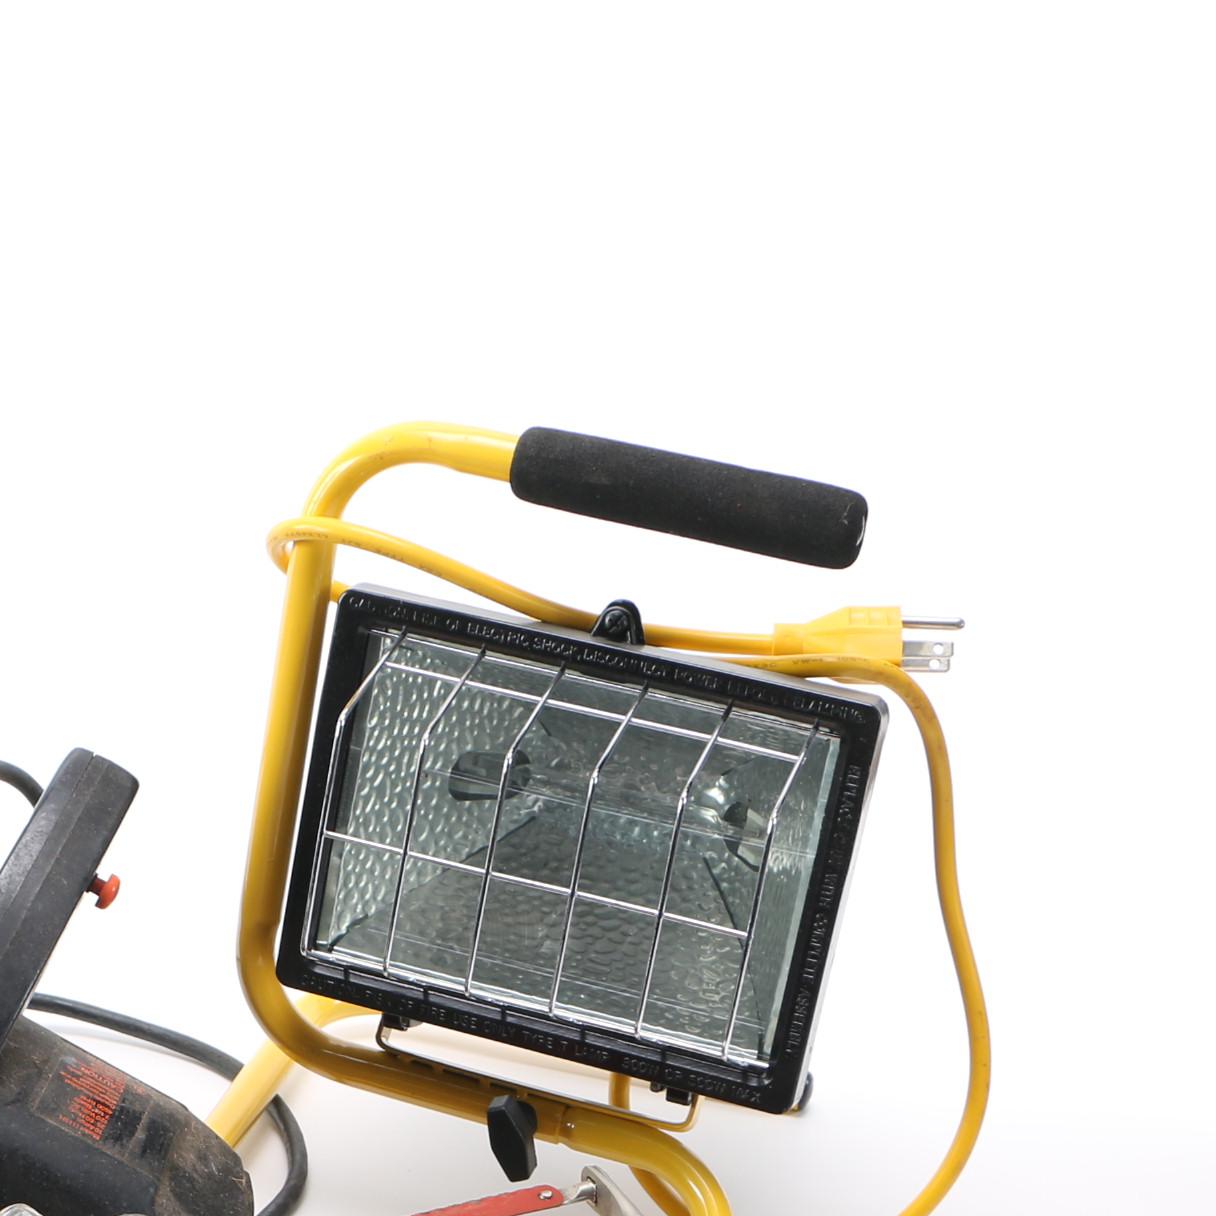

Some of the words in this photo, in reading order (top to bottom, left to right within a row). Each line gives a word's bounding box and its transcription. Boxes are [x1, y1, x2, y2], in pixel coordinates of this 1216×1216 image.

[466, 622, 531, 648] ELECTRIC
[581, 647, 668, 678] DISCONNECT
[672, 667, 720, 690] POWER
[452, 1012, 478, 1029] USE
[481, 1019, 517, 1040] ONLY
[519, 1031, 553, 1050] TYPE
